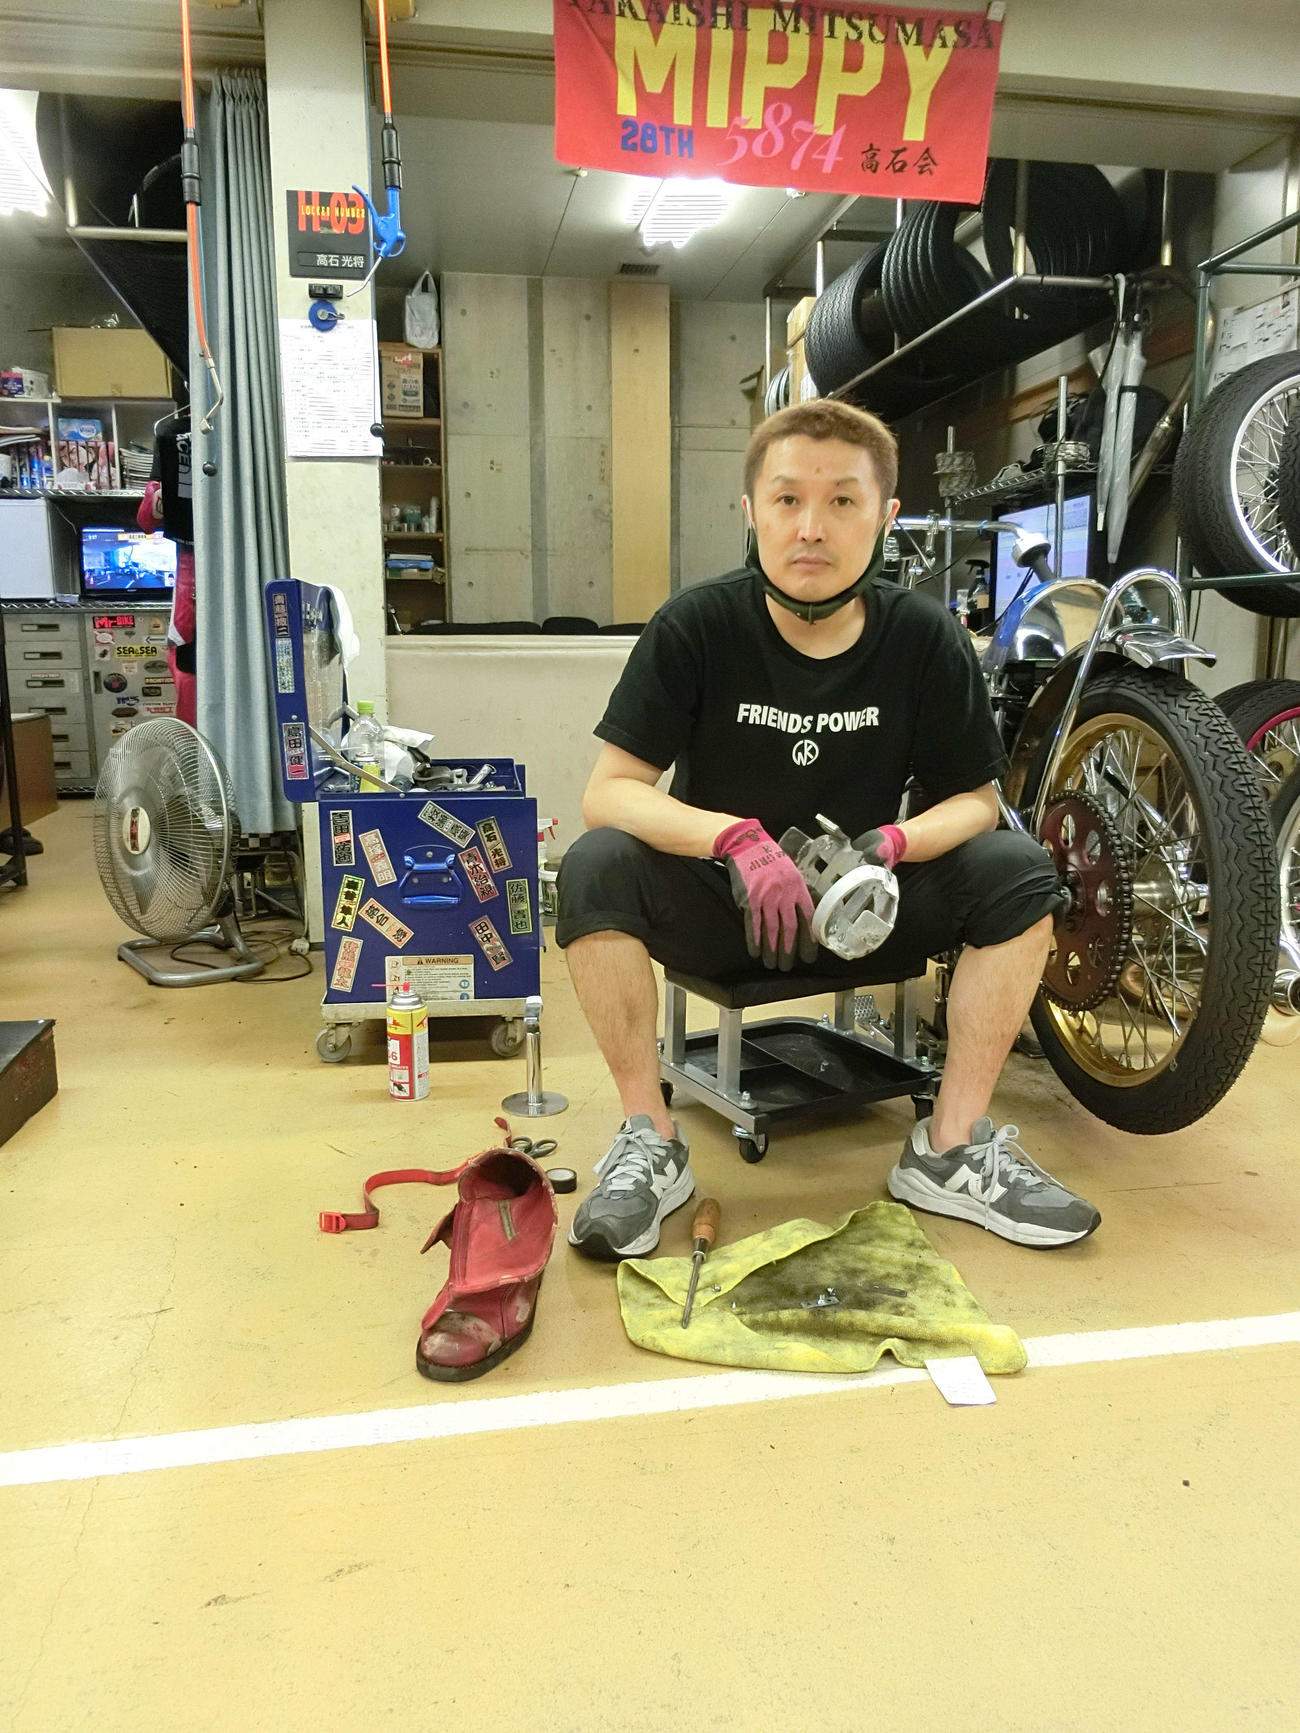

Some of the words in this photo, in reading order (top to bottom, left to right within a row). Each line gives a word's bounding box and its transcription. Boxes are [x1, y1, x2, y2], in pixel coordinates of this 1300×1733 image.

[773, 1, 995, 49] MITSUMASA
[614, 0, 957, 142] MIPPY
[620, 118, 695, 159] 28TH
[716, 102, 847, 174] 5874
[860, 143, 938, 176] 高石会
[298, 190, 365, 235] H-03
[301, 205, 330, 217] LOCKER
[335, 206, 366, 219] NUMBER
[736, 703, 814, 734] FRIENDS
[815, 706, 880, 733] POWER
